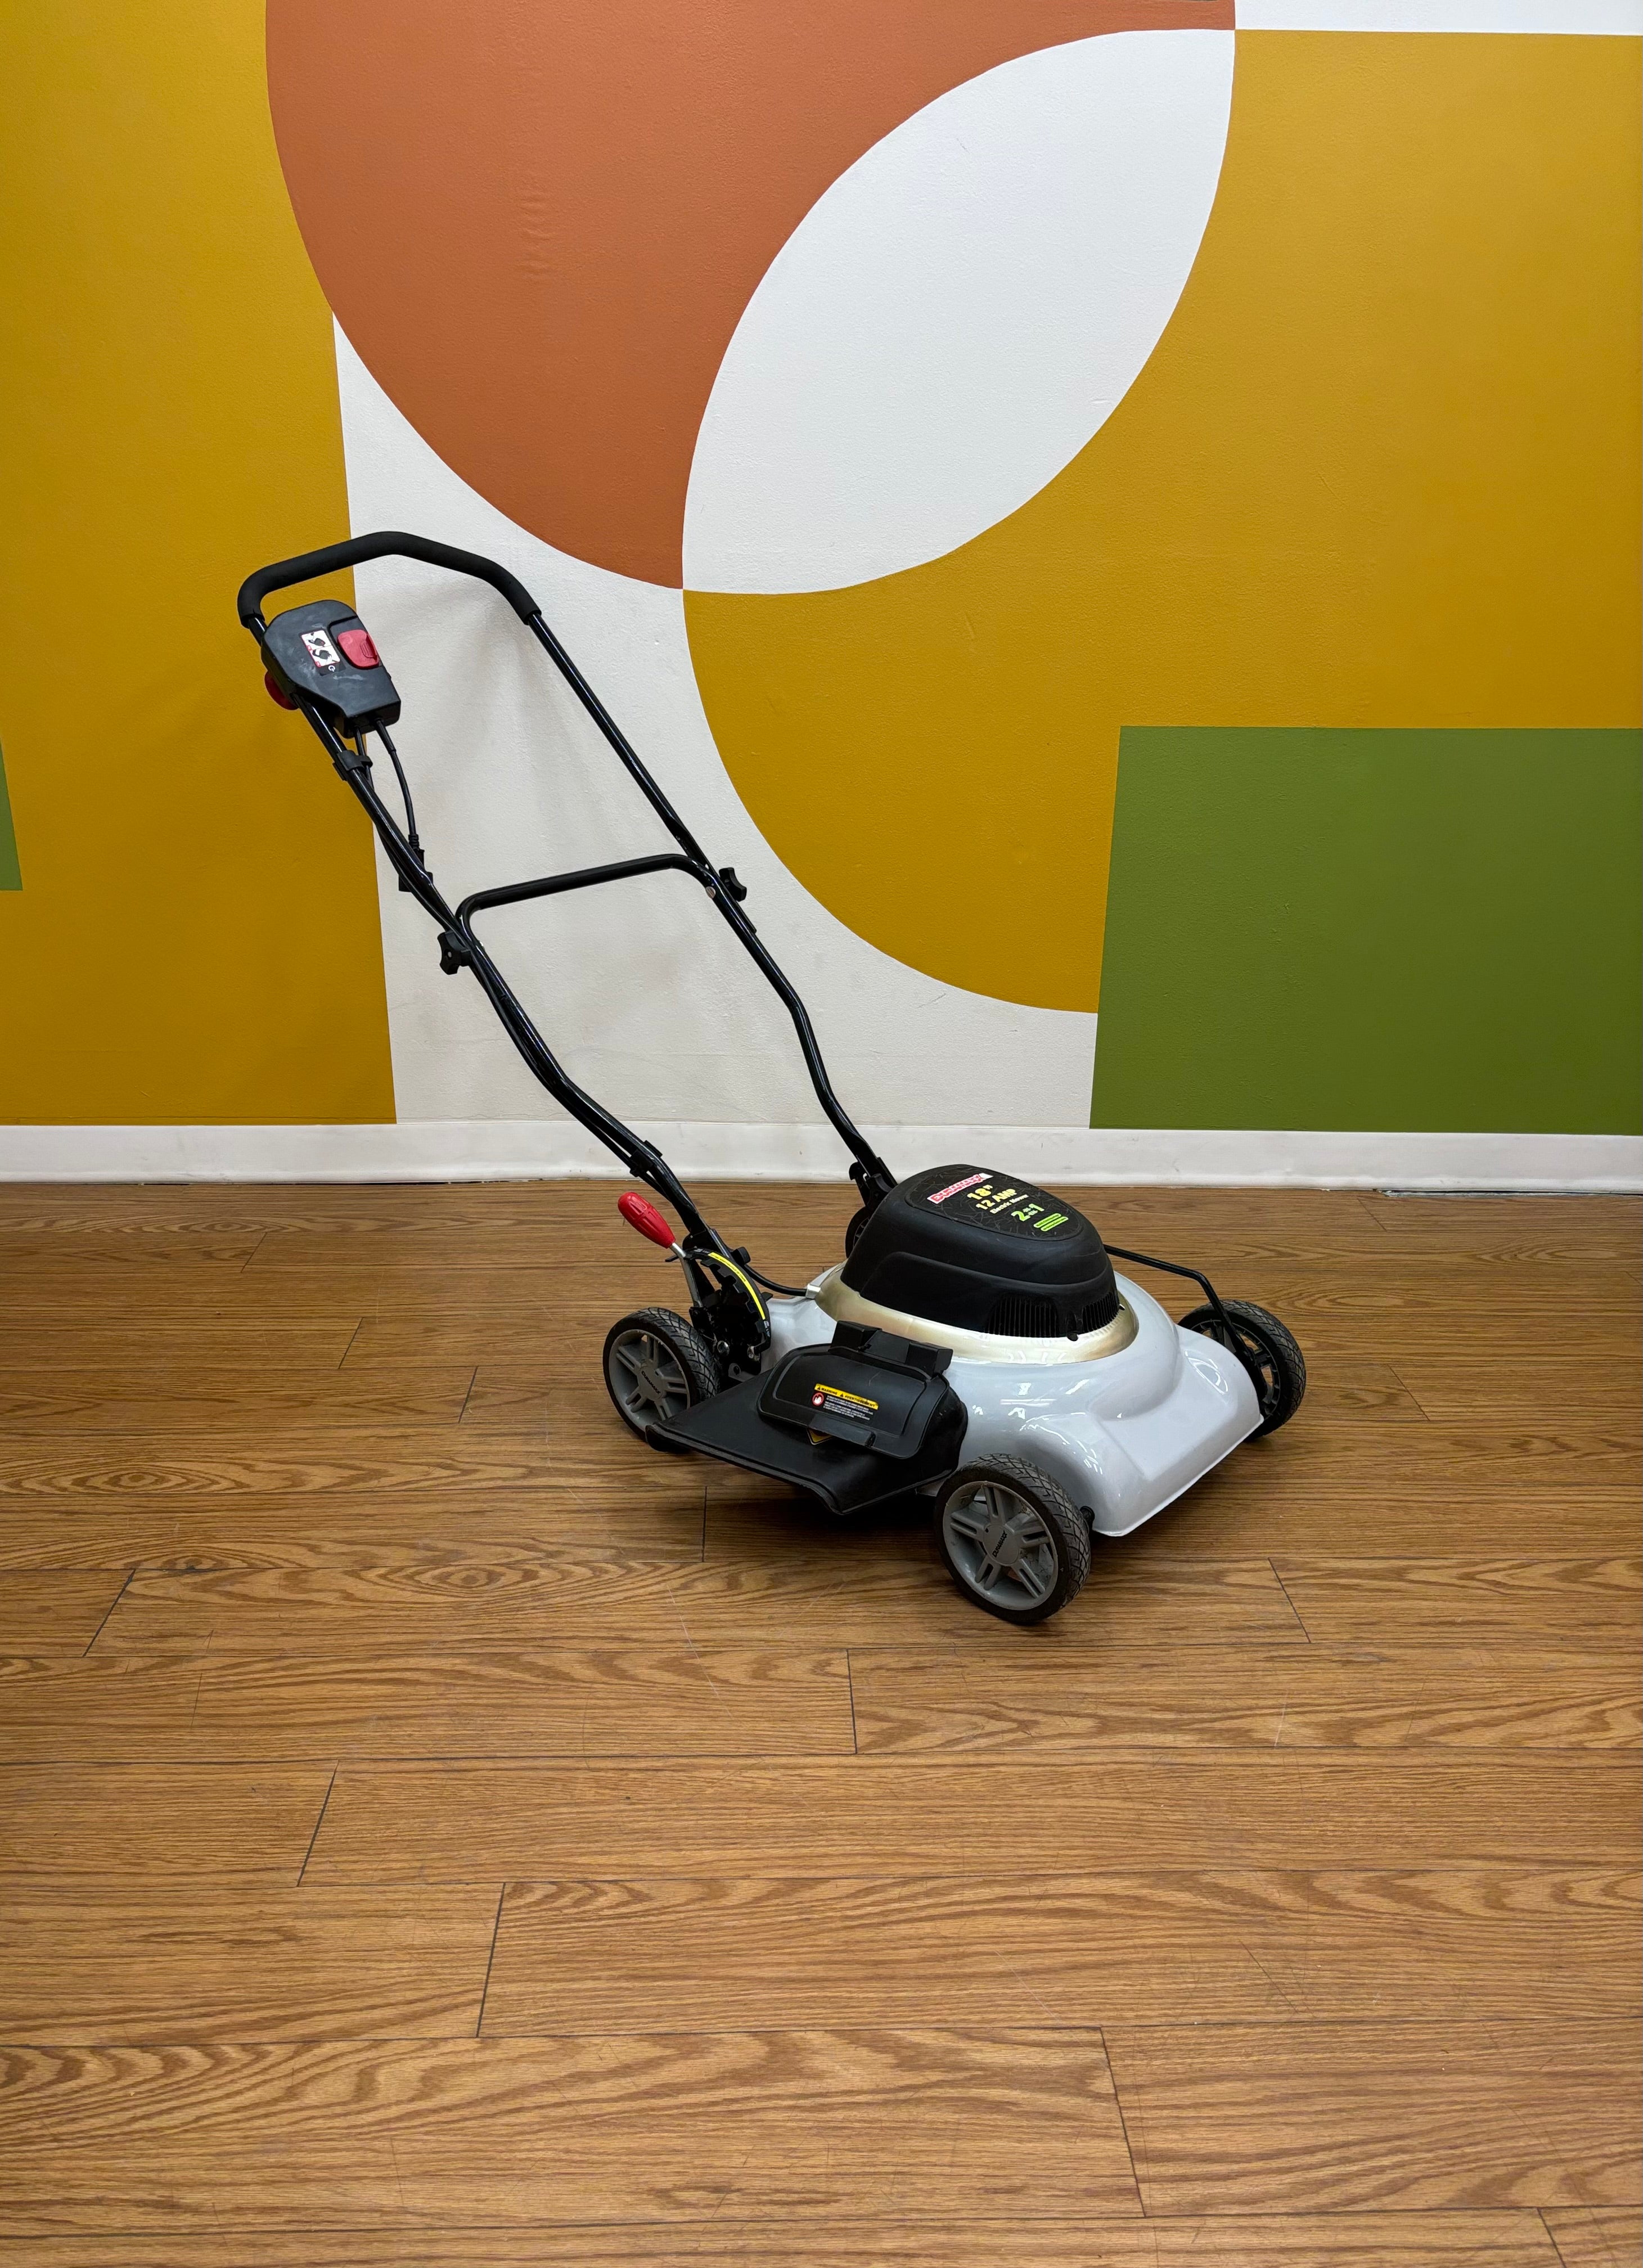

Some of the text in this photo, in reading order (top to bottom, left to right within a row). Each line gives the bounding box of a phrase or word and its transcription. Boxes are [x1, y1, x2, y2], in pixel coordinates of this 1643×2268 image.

[976, 1189, 1017, 1210] 12 AMP
[989, 1202, 1012, 1214] Electric
[844, 1394, 876, 1407] AVERTISSEMENT
[992, 1529, 1007, 1558] DURAMAXX
